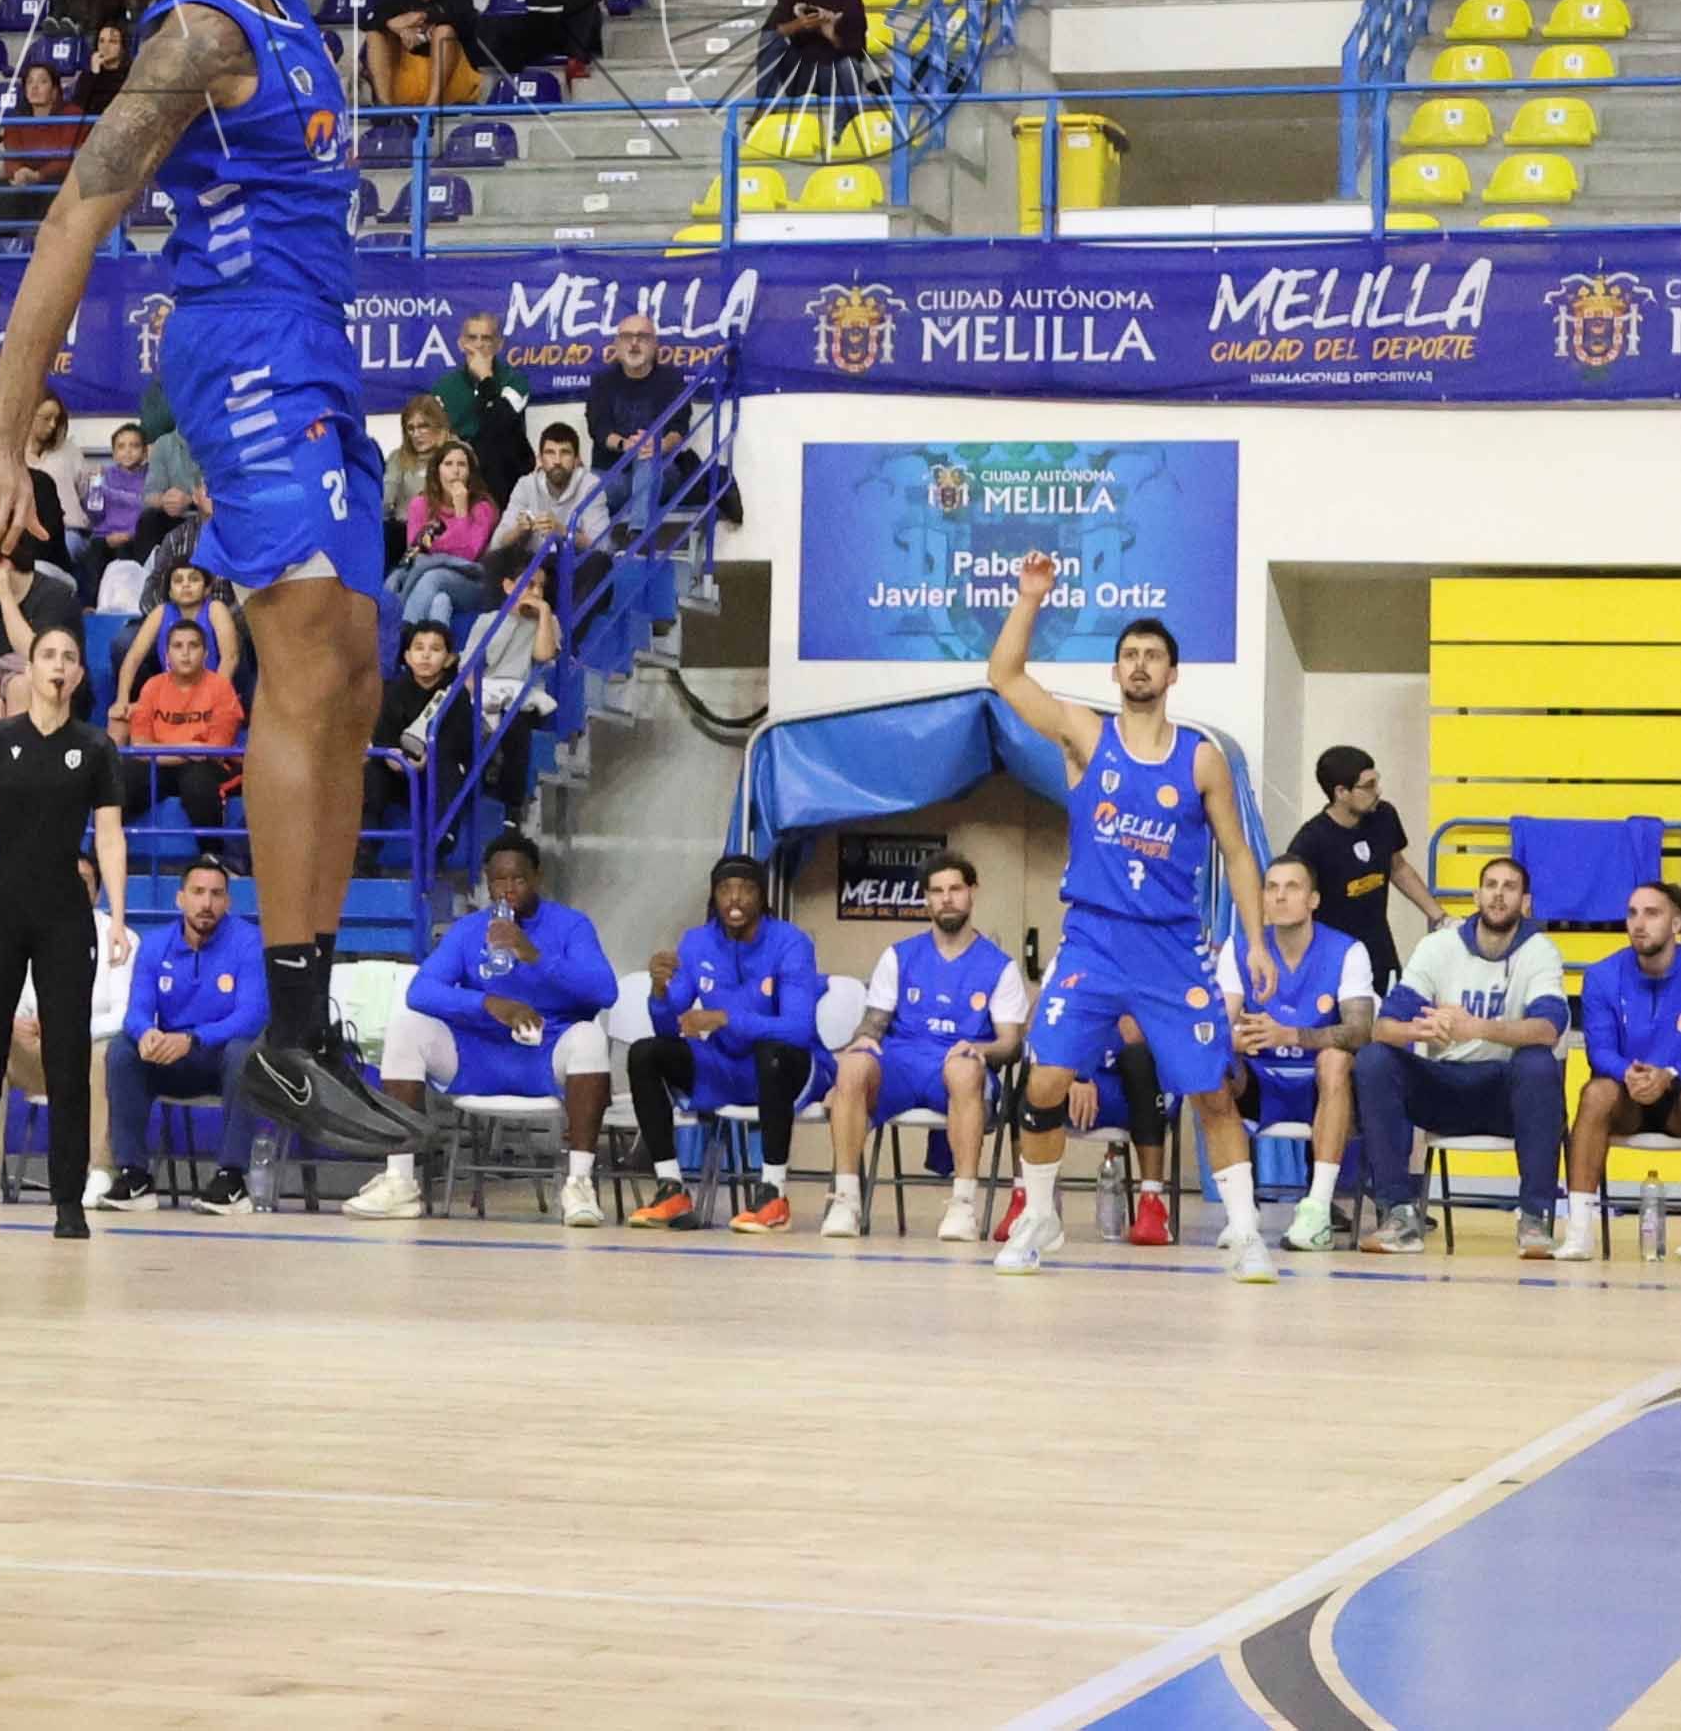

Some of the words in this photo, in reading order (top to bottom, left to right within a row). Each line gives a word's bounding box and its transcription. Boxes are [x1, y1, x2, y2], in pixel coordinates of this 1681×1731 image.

[917, 290, 1003, 310] CIUDAD
[1010, 285, 1155, 310] AUTÓNOMA
[1209, 257, 1493, 335] MELILLA
[921, 316, 1156, 363] MELILLA
[1210, 338, 1304, 364] CIUDAD
[1313, 336, 1361, 362] DEL
[1372, 334, 1477, 362] DEPORTE
[507, 344, 594, 366] CIUDAD
[980, 470, 1032, 484] CIUDAD
[1036, 467, 1116, 484] AUTÓNOMA
[984, 487, 1117, 515] MELILLA
[868, 582, 960, 609] Javier
[1128, 859, 1146, 891] 7
[842, 877, 929, 906] MELILL
[1046, 996, 1068, 1026] 7
